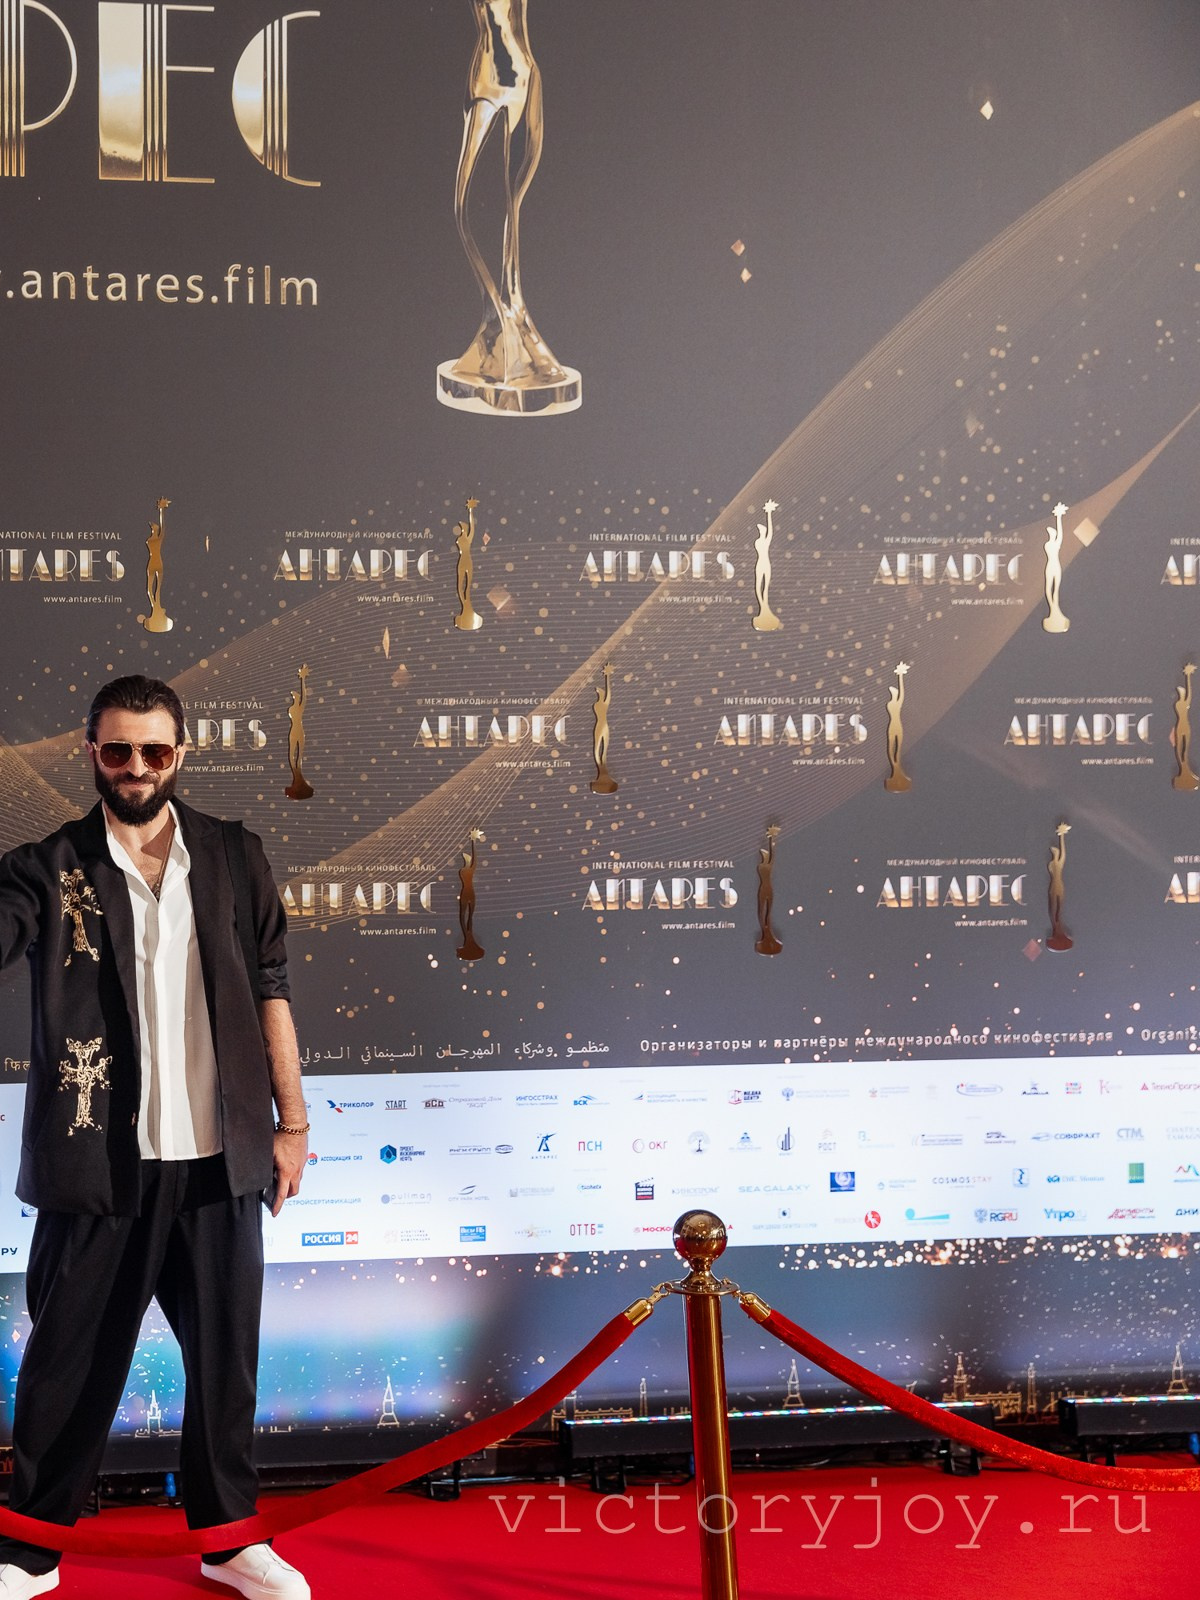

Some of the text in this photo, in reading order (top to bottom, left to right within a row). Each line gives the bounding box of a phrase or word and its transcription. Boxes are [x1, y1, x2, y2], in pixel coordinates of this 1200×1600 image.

[51, 531, 74, 540] FILM
[78, 531, 122, 540] FESTIVAL
[285, 531, 434, 539] МЕЖДУНАРОДНЫЙ КИНОФЕСТИВАЛЬ
[589, 533, 731, 542] INTERNATIONAL FILM FESTIVAL
[273, 548, 434, 582] АНТАРЕС
[579, 551, 735, 582] ANTARES
[873, 553, 1024, 585] АНТАРЕС
[43, 595, 122, 603] www.antares.film
[357, 594, 434, 602] www.antares.film
[659, 595, 733, 603] www.antares.film
[194, 701, 216, 709] FILM
[220, 701, 264, 709] FESTIVAL
[724, 697, 864, 705] INTERNATIONAL FILM FESTIVAL
[413, 715, 570, 747] АНТАРЕС
[714, 714, 867, 746] ANTARES
[1003, 713, 1153, 745] АНТАРЕС
[184, 719, 267, 751] ARES
[186, 764, 264, 772] www.antares.film
[495, 760, 571, 768] www.antares.film
[287, 864, 437, 873] МЕЖДУНАРОДНЫЙ КИНОФЕСТИВАЛЬ
[592, 861, 665, 869] INTERNATIONAL
[693, 860, 734, 868] FESTIVAL
[581, 877, 738, 911] ANTARES
[876, 874, 1028, 908] АНТАРЕС
[283, 881, 437, 915] АНТАРЕС
[661, 921, 735, 930] www.antares.film
[955, 918, 1027, 927] www.antares.film
[360, 927, 437, 935] www.antares.film
[1141, 1027, 1200, 1044] Organiz
[640, 1030, 1113, 1053] Организаторы и партнёры международного кинофестиваля
[385, 1100, 407, 1109] START
[578, 1141, 602, 1151] ПСН
[304, 1233, 358, 1245] РОССИЯ 24
